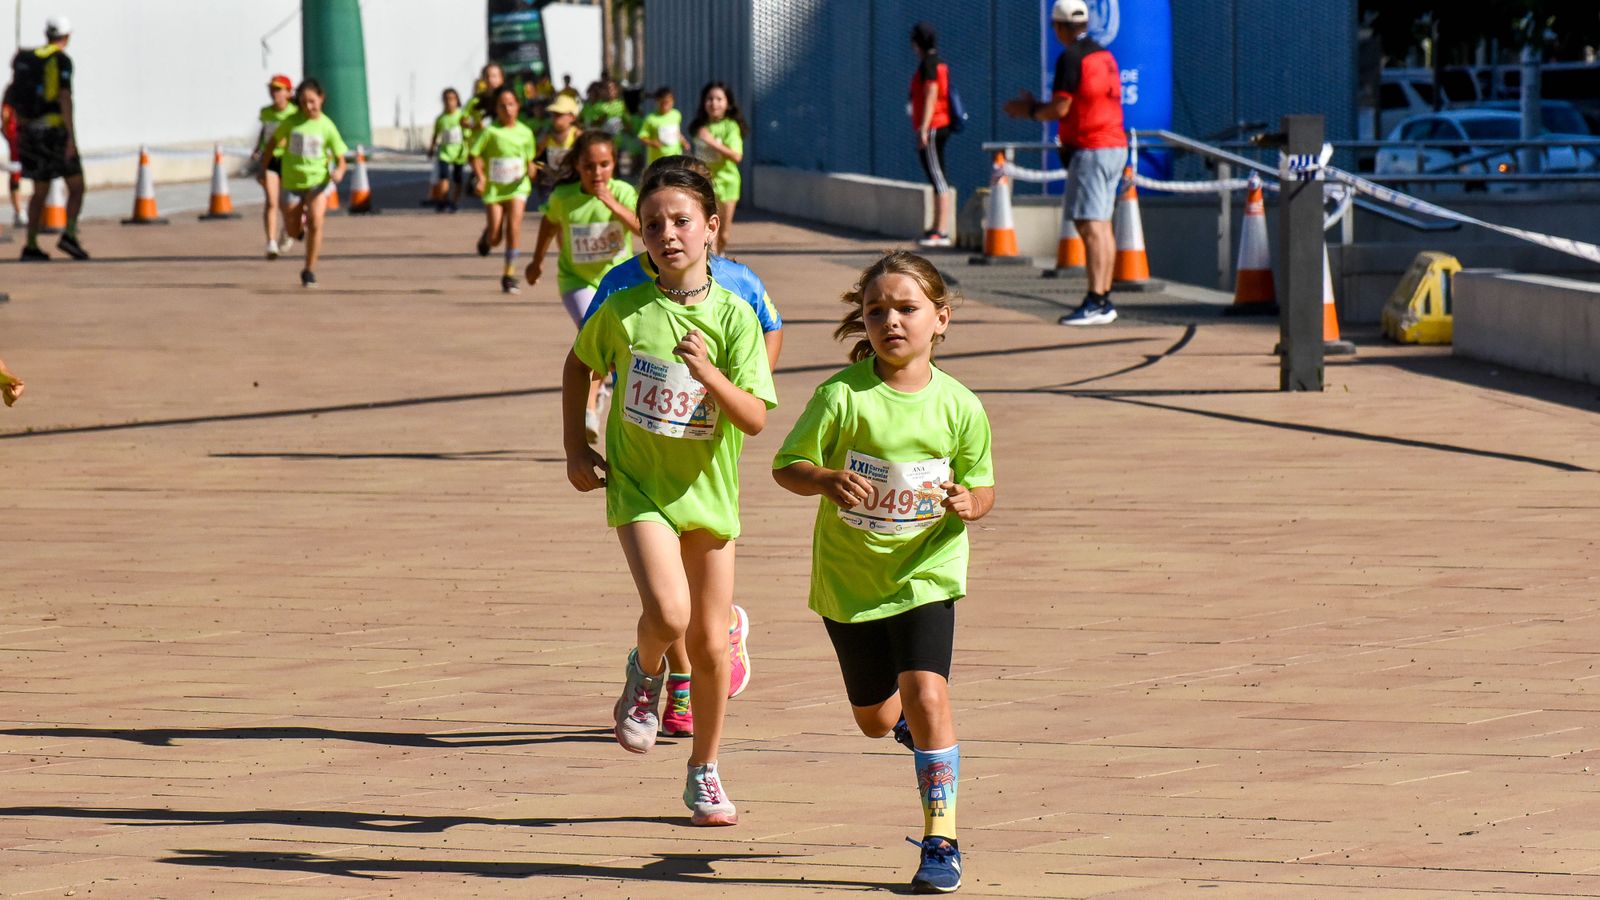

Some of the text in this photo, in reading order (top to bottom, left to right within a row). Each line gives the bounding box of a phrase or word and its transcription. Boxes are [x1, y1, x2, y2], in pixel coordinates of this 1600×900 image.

[634, 358, 651, 373] XXI
[632, 380, 690, 417] 1433
[850, 459, 889, 474] XXI Carrera
[869, 470, 889, 479] Popular
